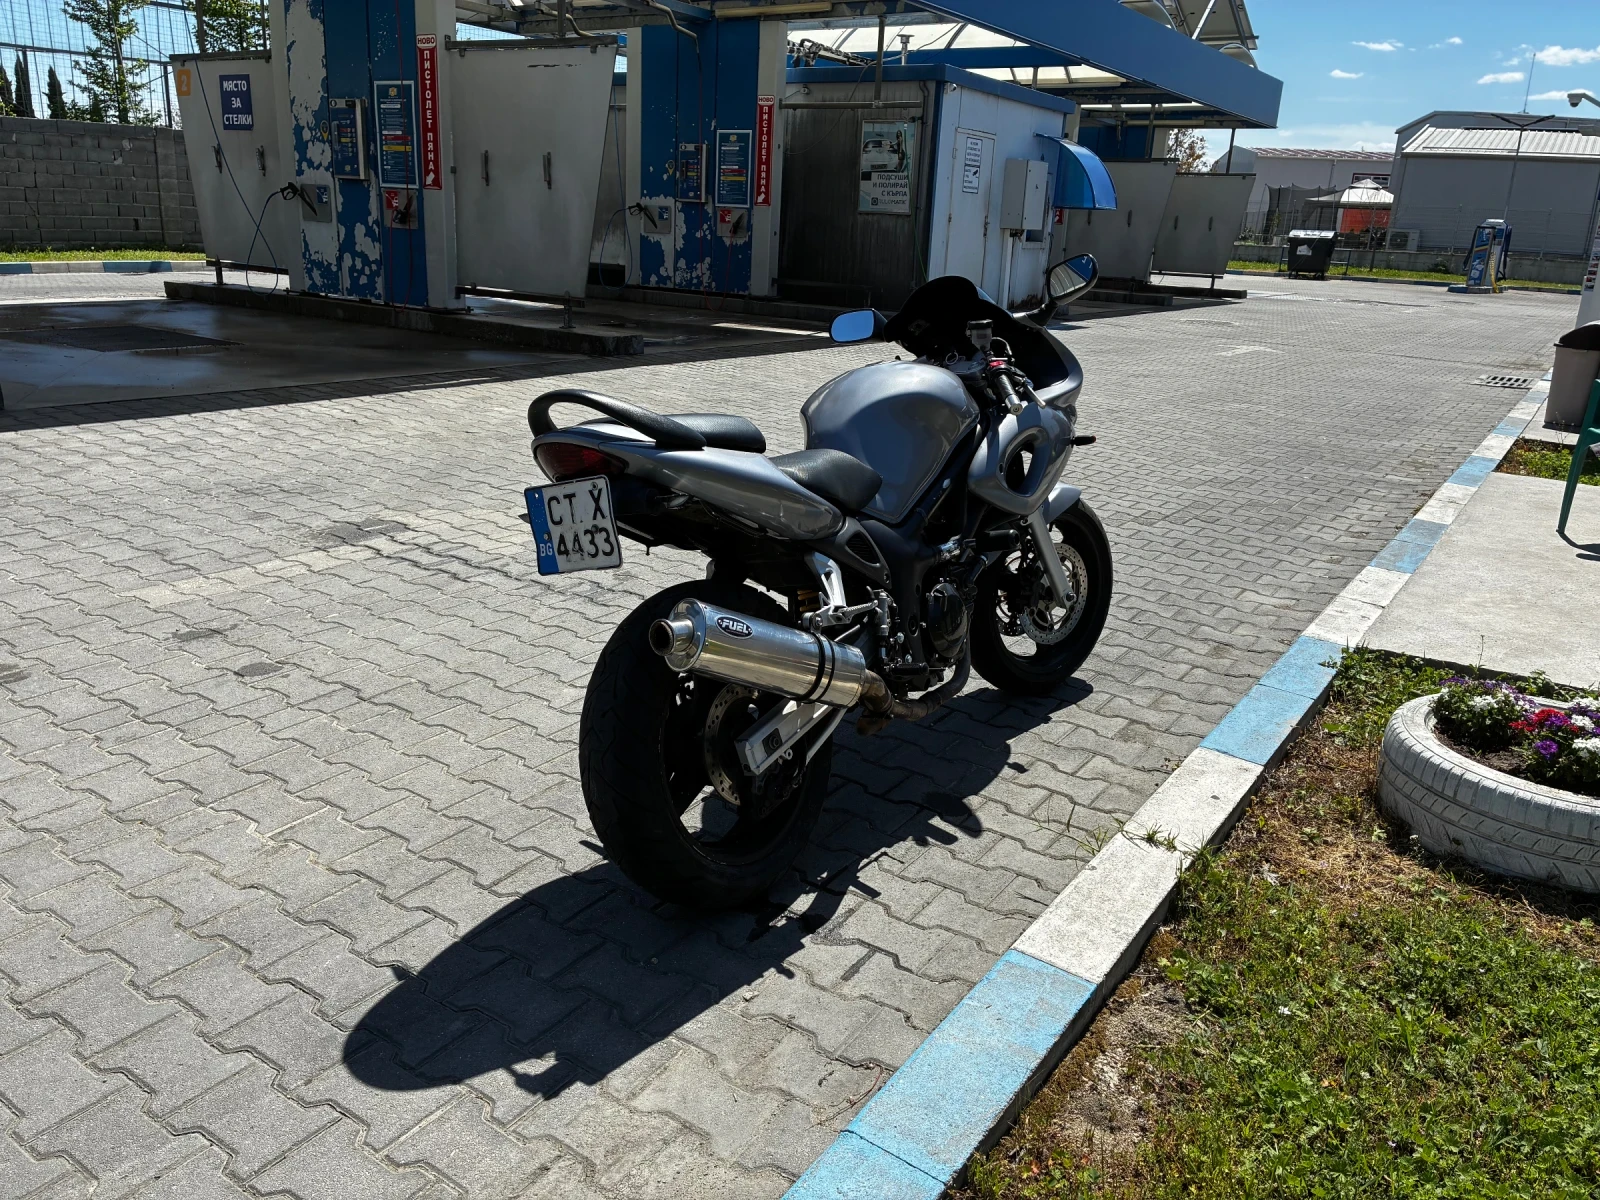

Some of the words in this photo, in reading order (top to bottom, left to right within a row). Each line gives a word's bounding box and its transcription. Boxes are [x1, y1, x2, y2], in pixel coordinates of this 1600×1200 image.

[417, 36, 435, 45] НОВО
[181, 74, 188, 91] 2
[222, 80, 248, 92] МЯСТО
[424, 50, 433, 128] ПИСТОЛЕТ
[231, 97, 242, 108] ЗА
[223, 114, 253, 125] СТЕЛКИ
[761, 106, 769, 162] ПИСТОЛЕТ
[427, 133, 435, 170] ПЯНА
[877, 173, 907, 181] ПОДСУШИ
[878, 181, 908, 189] ПОЛИРАЙ
[547, 493, 576, 526] CT
[588, 488, 607, 520] X
[540, 543, 553, 556] BG
[557, 526, 615, 560] 4433
[721, 618, 749, 635] FUEL
